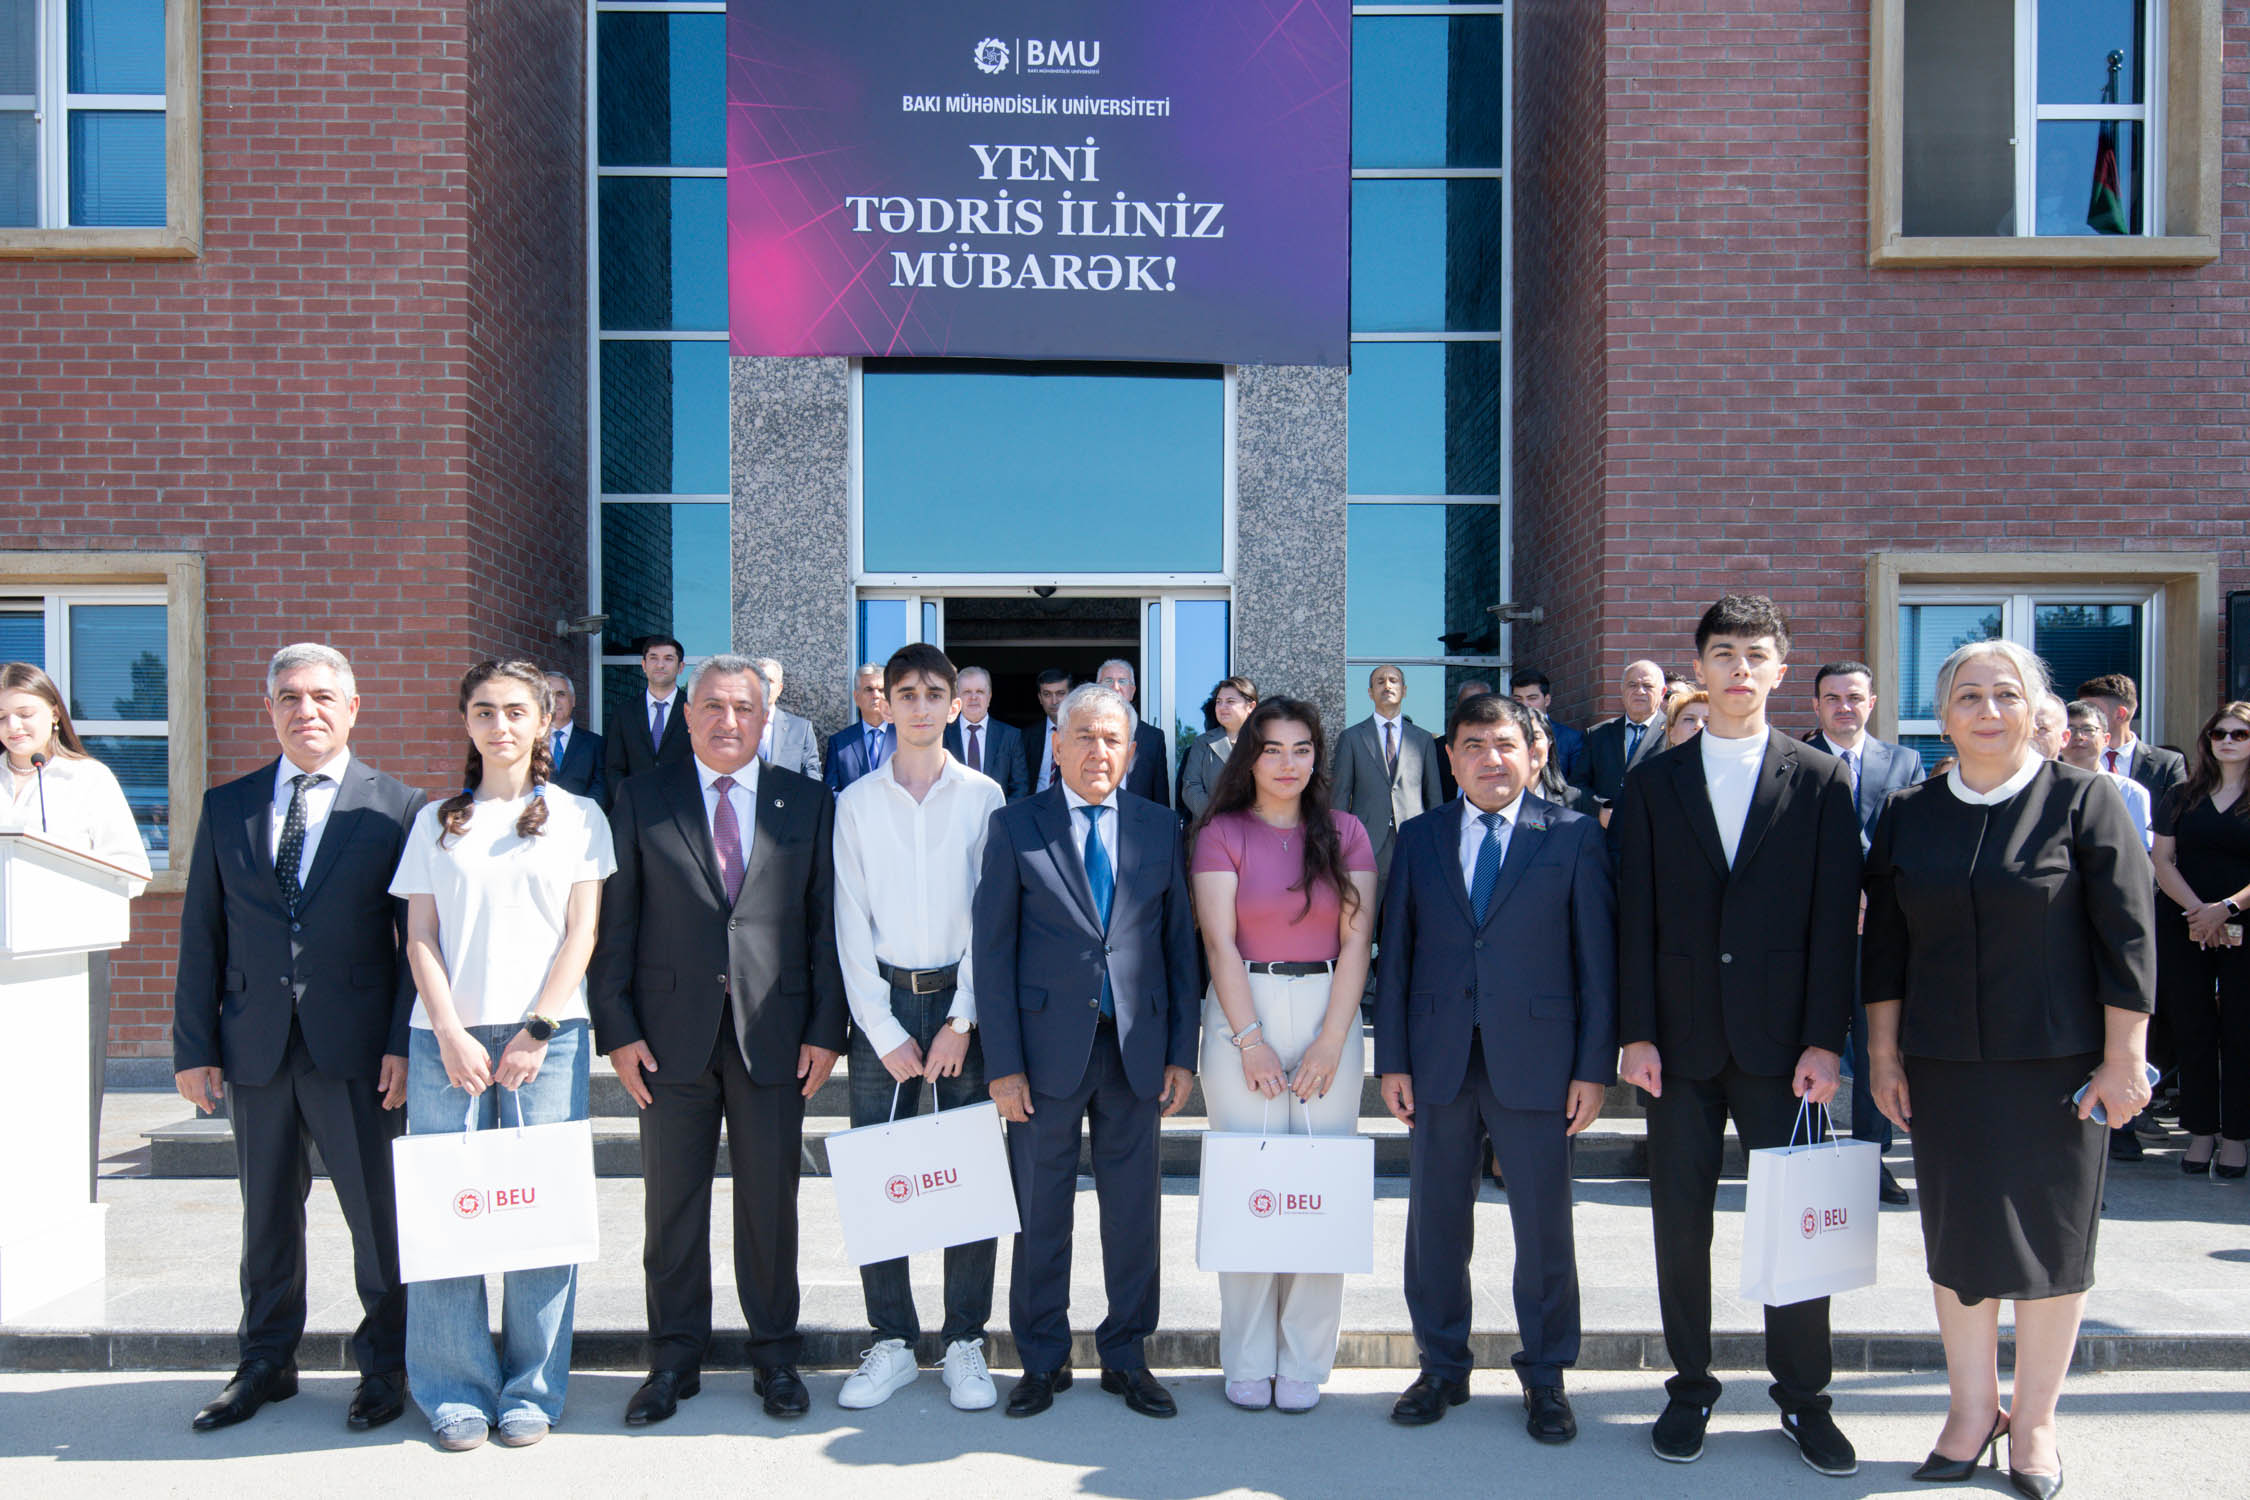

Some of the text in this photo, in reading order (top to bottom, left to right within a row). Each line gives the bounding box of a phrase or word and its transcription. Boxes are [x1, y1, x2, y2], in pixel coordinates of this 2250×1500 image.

[1027, 39, 1100, 67] BMU
[902, 93, 1170, 117] BAKI MÜHƏNDİSLİK UNİVERSİTETİ
[969, 136, 1100, 182] YENİ
[845, 188, 1225, 238] TƏDRİS İLİNİZ
[889, 242, 1177, 292] MÜBARƏK!
[921, 1167, 958, 1189] BEU
[496, 1187, 535, 1206] BEU
[1286, 1193, 1322, 1210] BEU
[1824, 1207, 1847, 1227] BEU
